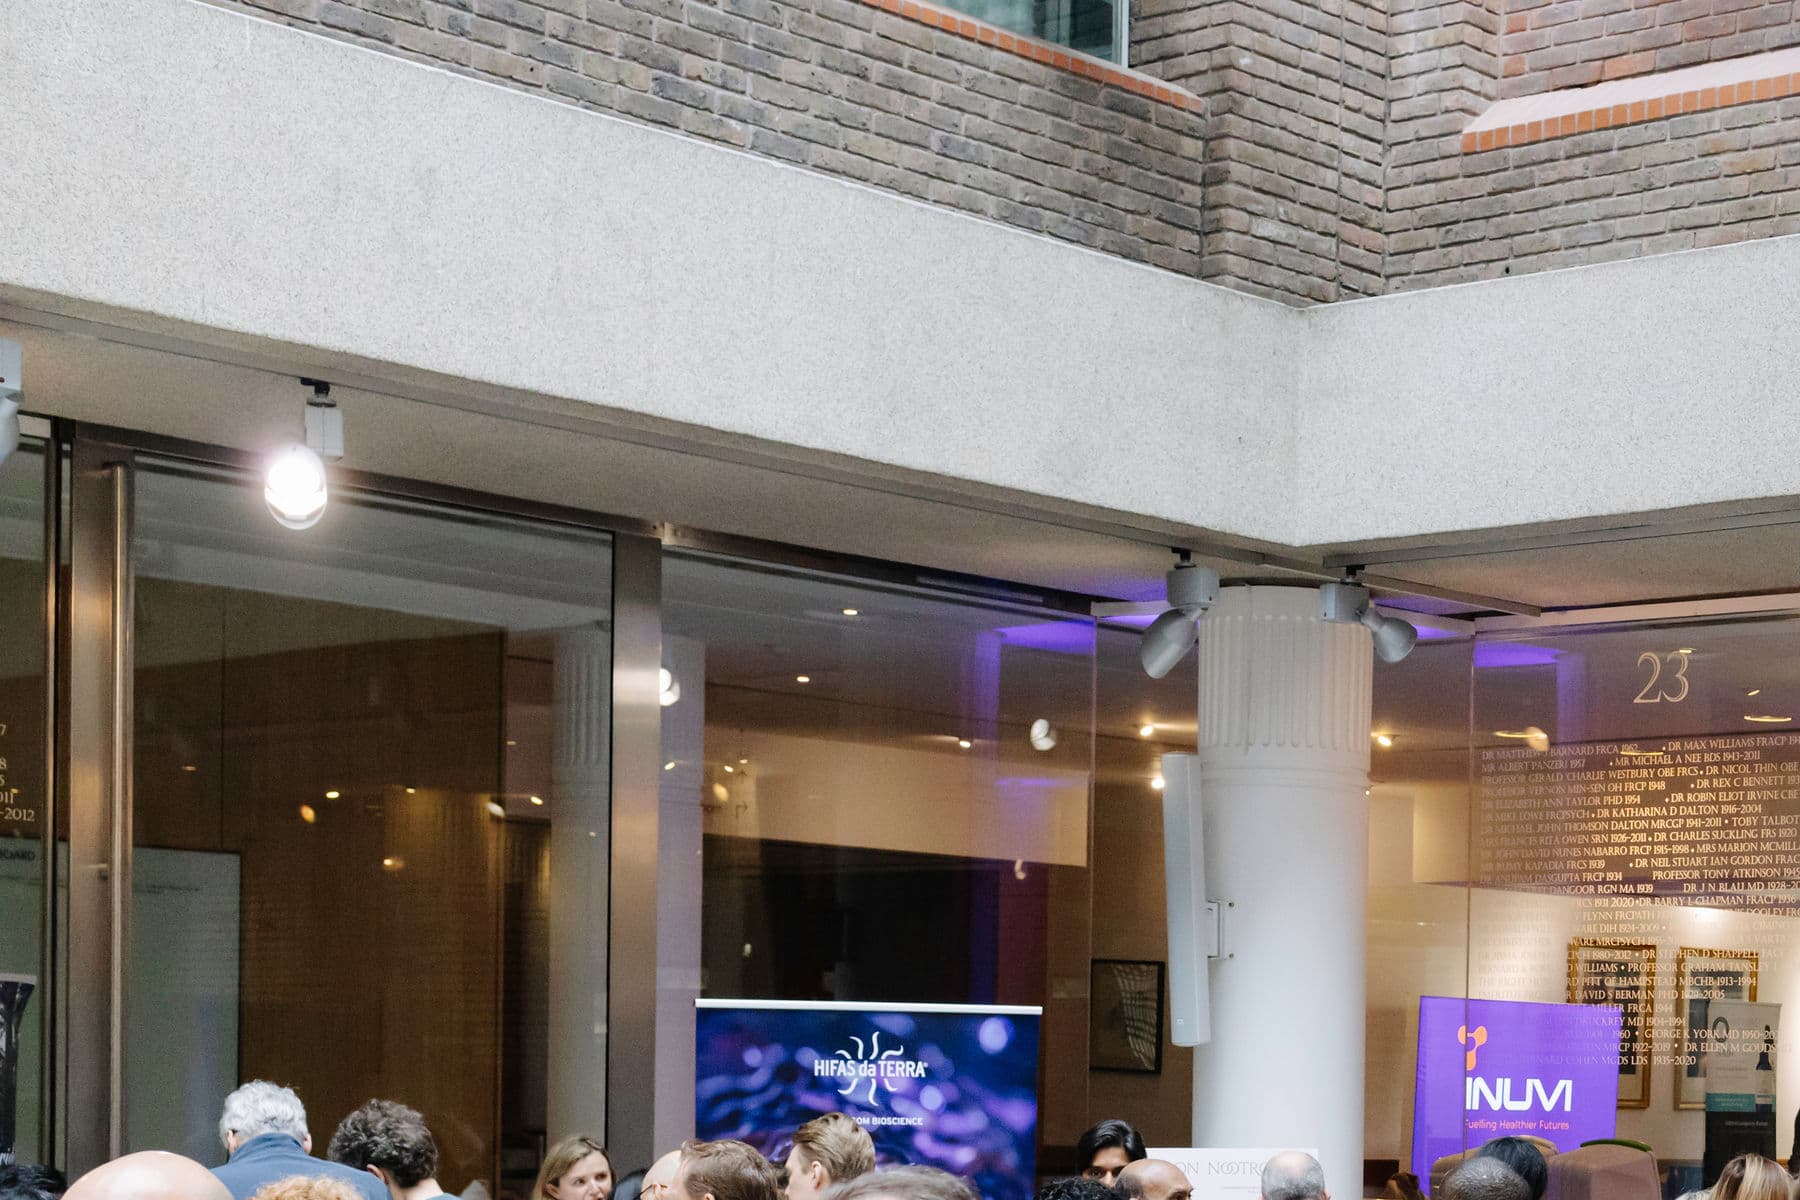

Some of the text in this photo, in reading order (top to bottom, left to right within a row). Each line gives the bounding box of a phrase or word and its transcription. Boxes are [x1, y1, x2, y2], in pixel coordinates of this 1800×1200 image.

[1633, 650, 1690, 704] 23
[1612, 804, 1762, 818] KATHARINA D DALTON 1916-2004
[1611, 815, 1800, 830] DALTON MRCGP 1941-2011 TOBY TALBOT
[1584, 846, 1627, 856] NABARRO
[1630, 845, 1651, 855] FRCP
[1731, 855, 1772, 866] GORDON
[1703, 868, 1781, 879] TONY ATKINSON
[814, 1060, 855, 1076] HIFAS
[859, 1060, 876, 1076] da
[1466, 1077, 1572, 1112] INUVI
[872, 1117, 923, 1125] BIOSCIENCE
[1500, 1120, 1536, 1129] Healthier
[1540, 1120, 1569, 1130] Futures
